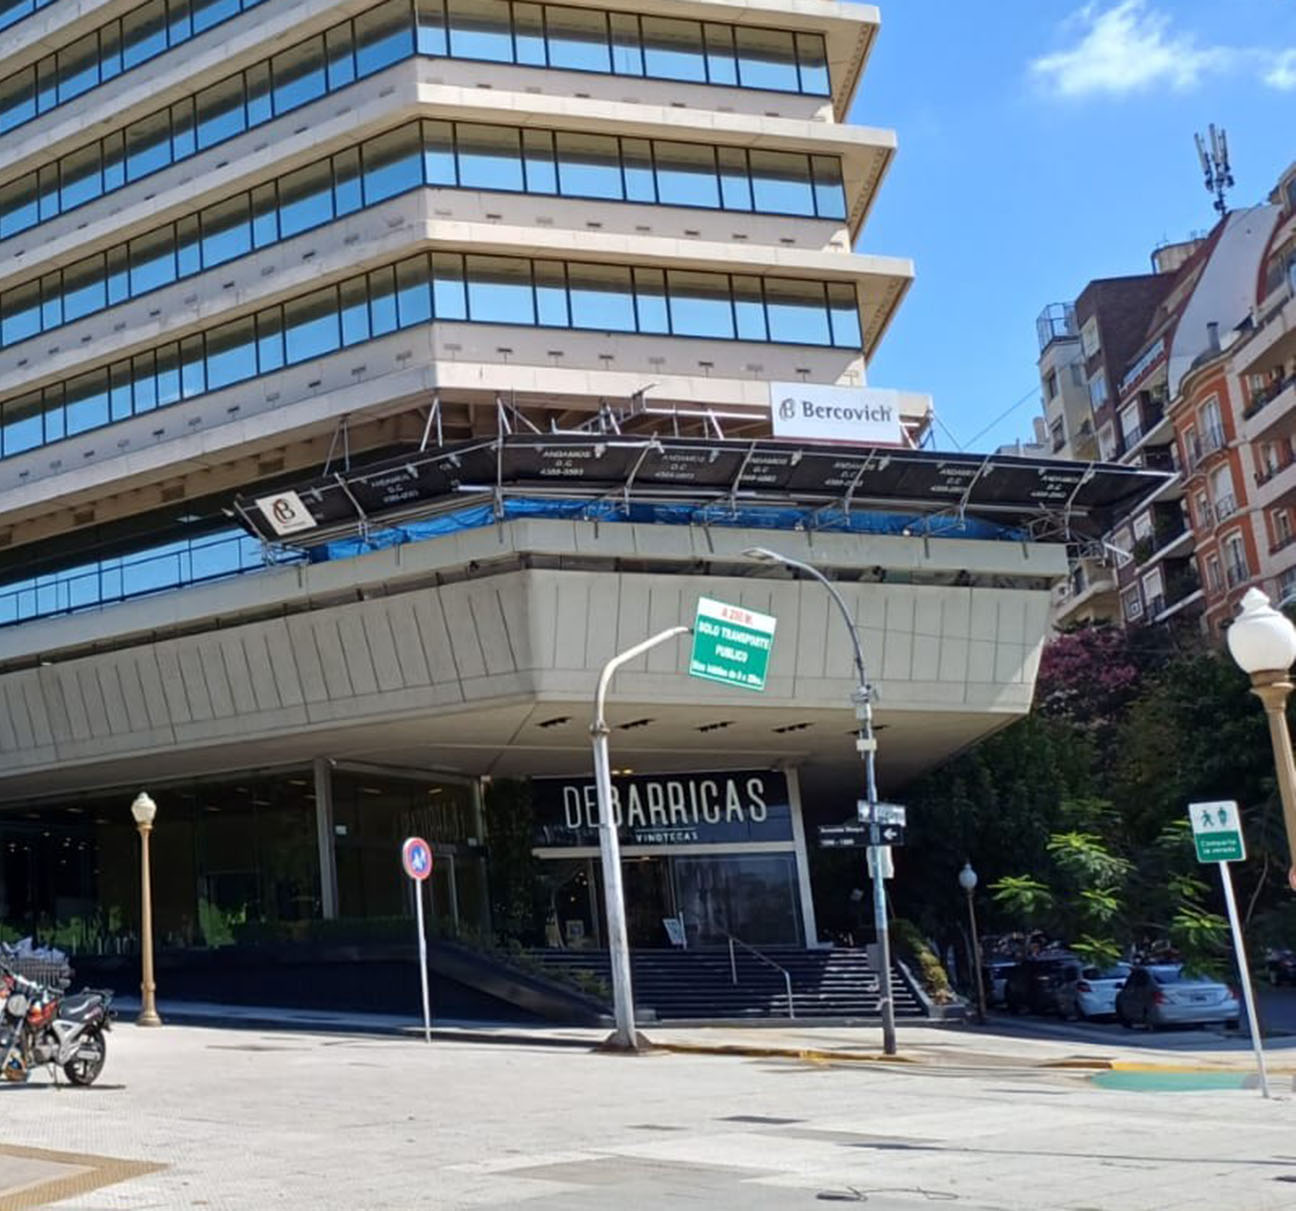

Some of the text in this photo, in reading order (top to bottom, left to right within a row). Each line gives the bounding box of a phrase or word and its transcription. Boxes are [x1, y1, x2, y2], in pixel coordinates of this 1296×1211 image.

[802, 400, 891, 422] Bercovich
[698, 620, 771, 651] SOLO TRANSPORTE
[563, 778, 767, 829] DEBARRICAS
[635, 831, 699, 842] VINOTECAS
